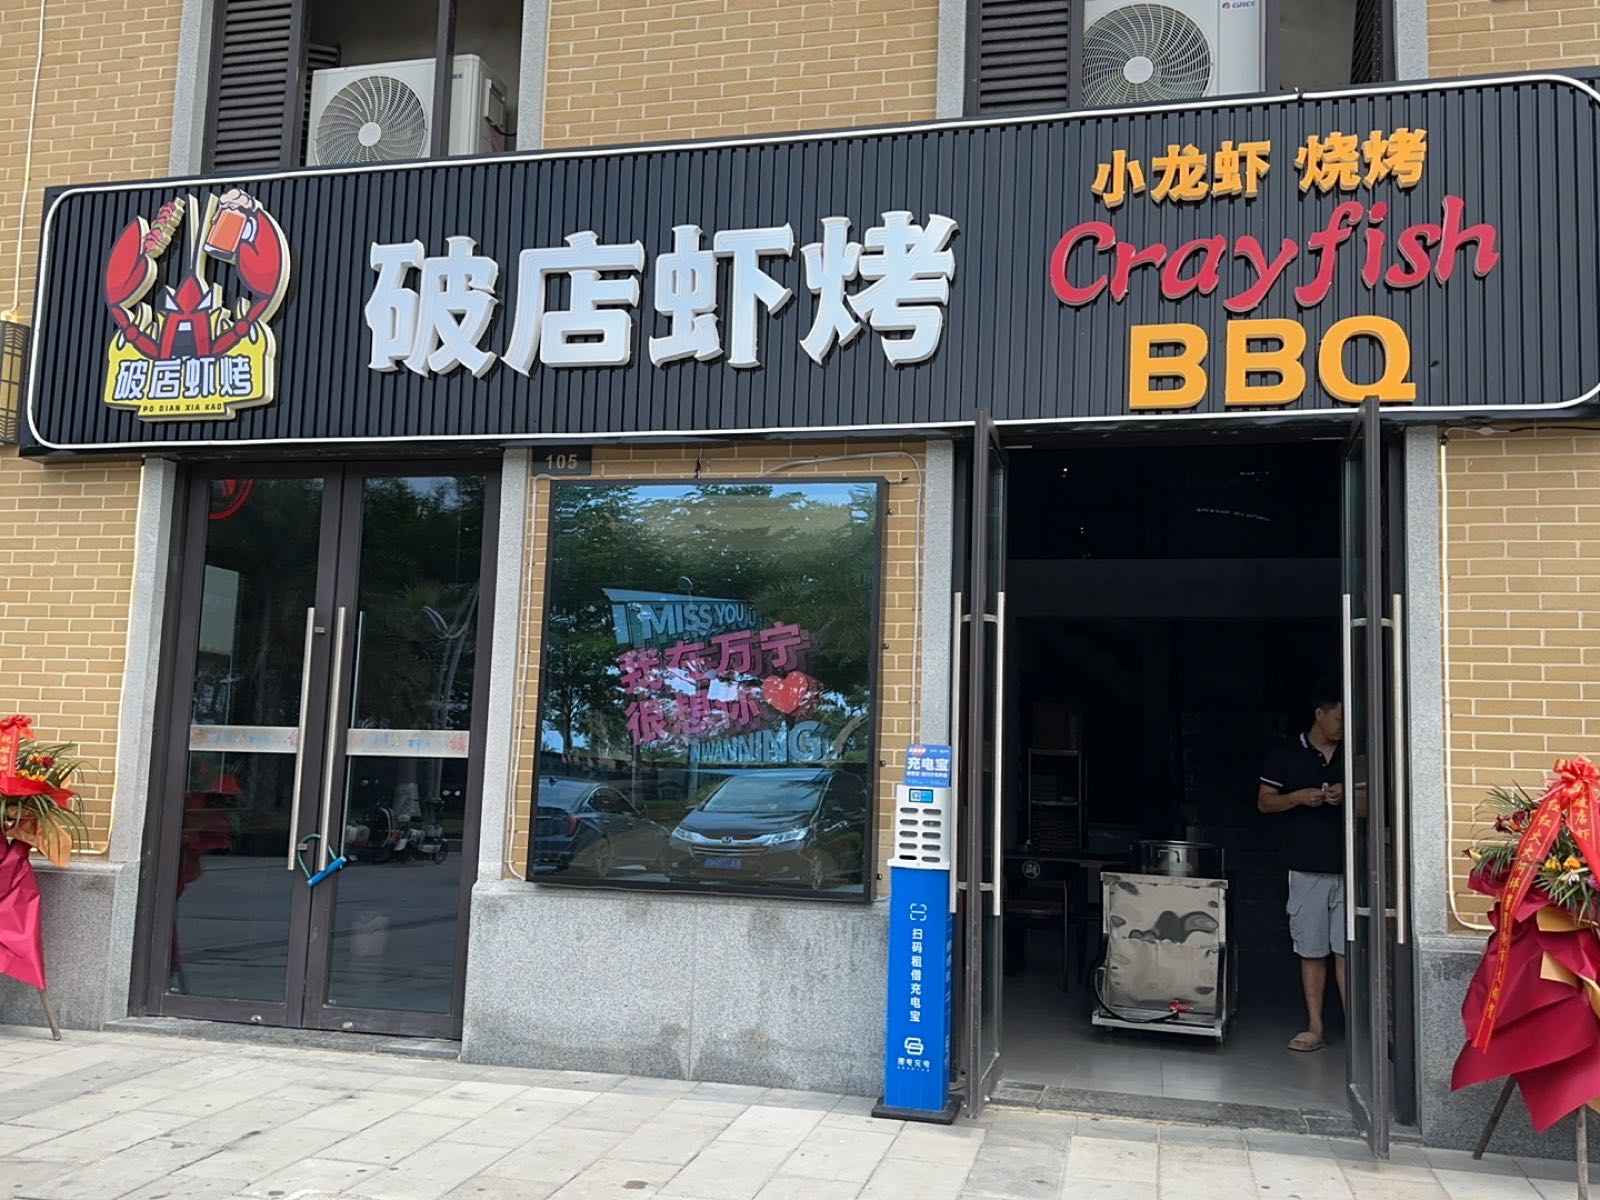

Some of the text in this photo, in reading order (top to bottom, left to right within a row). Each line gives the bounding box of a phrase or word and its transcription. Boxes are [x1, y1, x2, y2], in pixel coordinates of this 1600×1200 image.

[1090, 128, 1428, 210] 小龙虾 烧烤
[1049, 194, 1500, 314] Crayfish
[364, 209, 960, 379] 破店虾烤
[113, 355, 252, 400] 破店虾烤
[1129, 314, 1417, 411] BBQ
[159, 404, 181, 412] DIAN
[185, 403, 201, 411] XIA
[545, 453, 578, 470] 105
[640, 603, 714, 640] MISS
[715, 603, 744, 626] YOU
[907, 756, 949, 772] 充电宝
[909, 927, 923, 1023] 扫码租借充电宝
